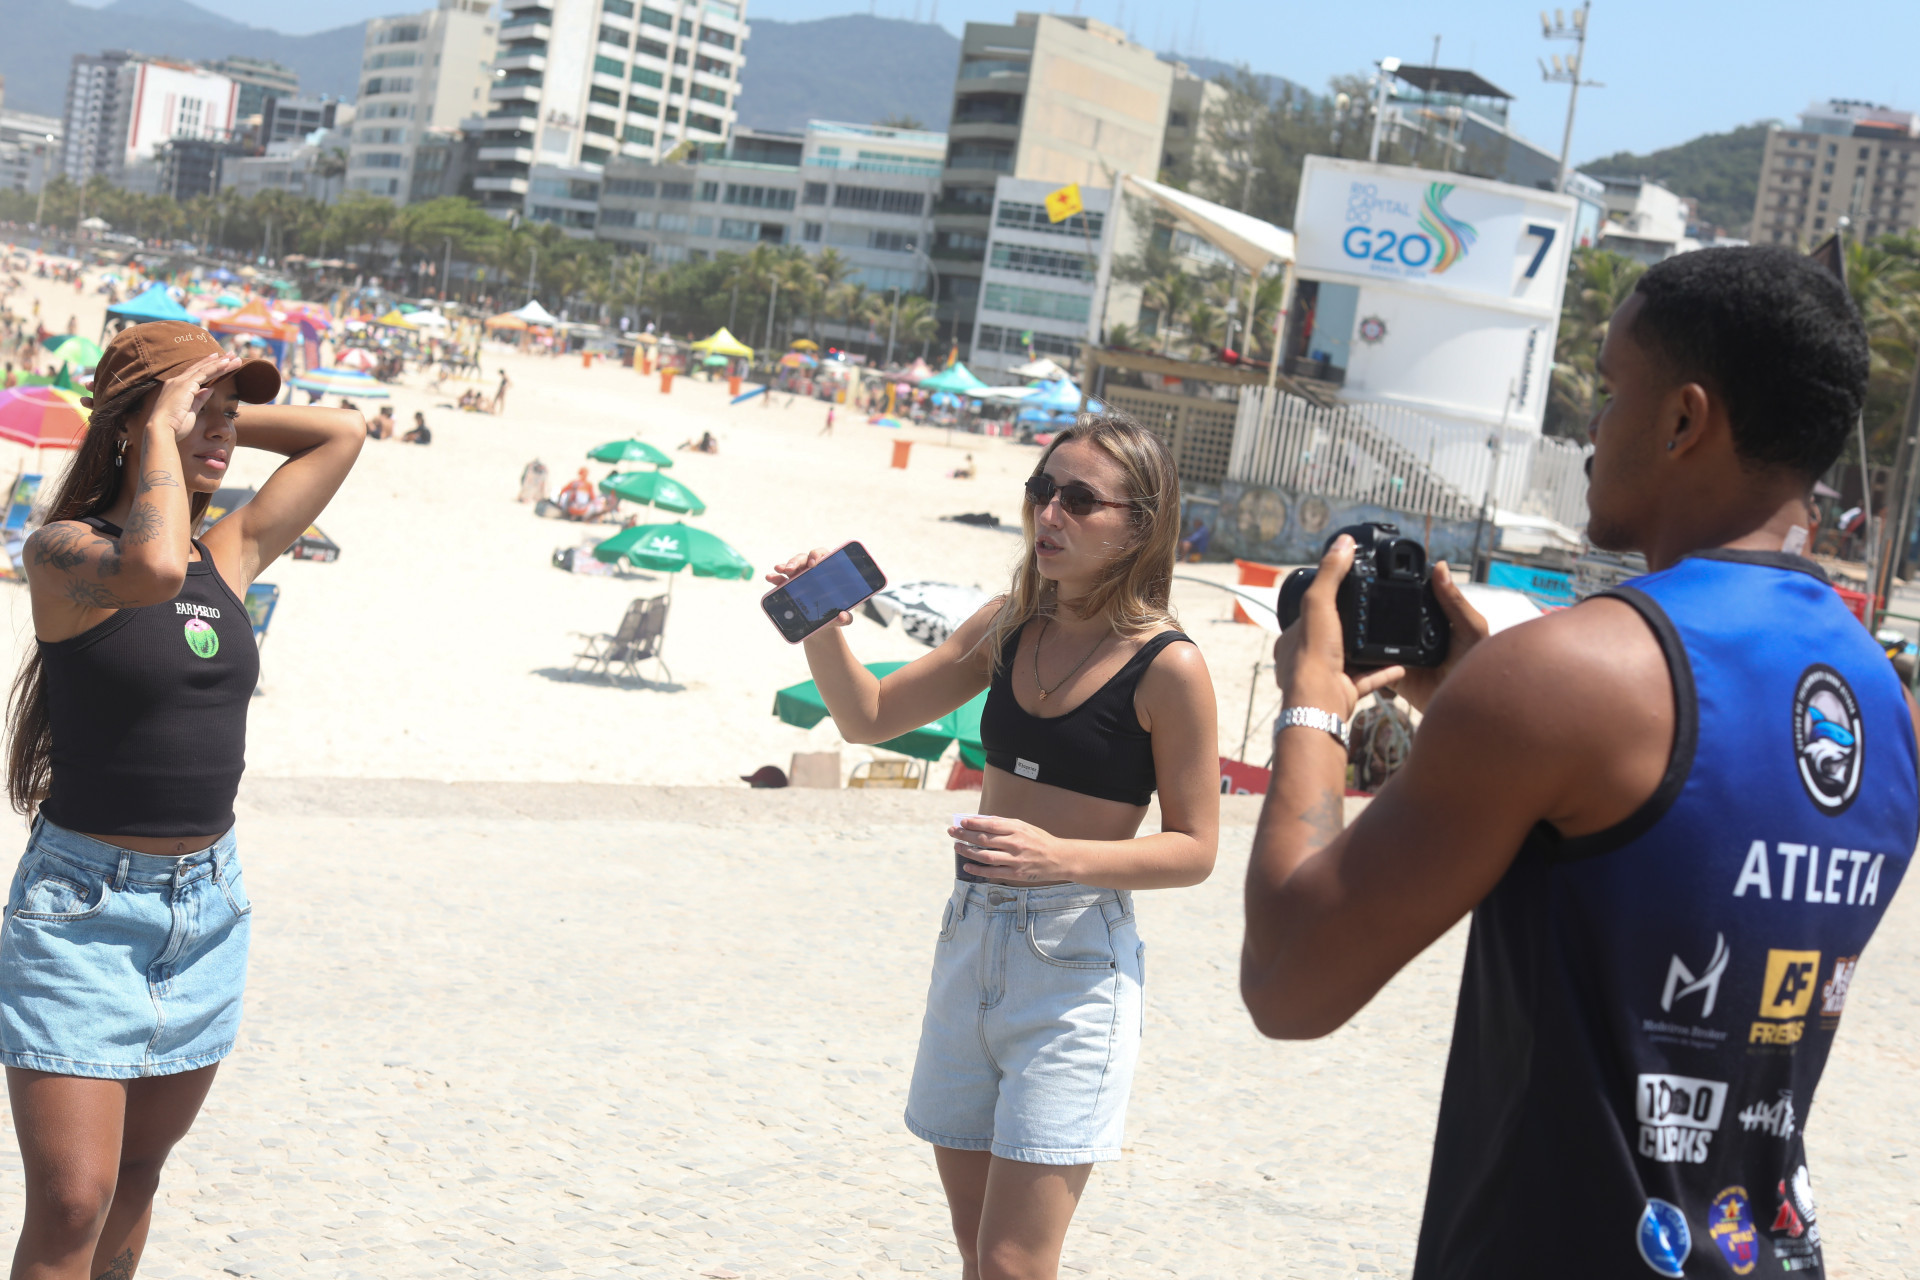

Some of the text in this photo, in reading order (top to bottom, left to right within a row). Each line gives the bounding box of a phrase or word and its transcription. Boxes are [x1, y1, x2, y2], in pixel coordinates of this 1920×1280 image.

[1343, 226, 1431, 268] G20
[1526, 224, 1556, 278] 7
[174, 332, 194, 343] out
[196, 332, 208, 343] of
[1733, 840, 1885, 906] ATLETA
